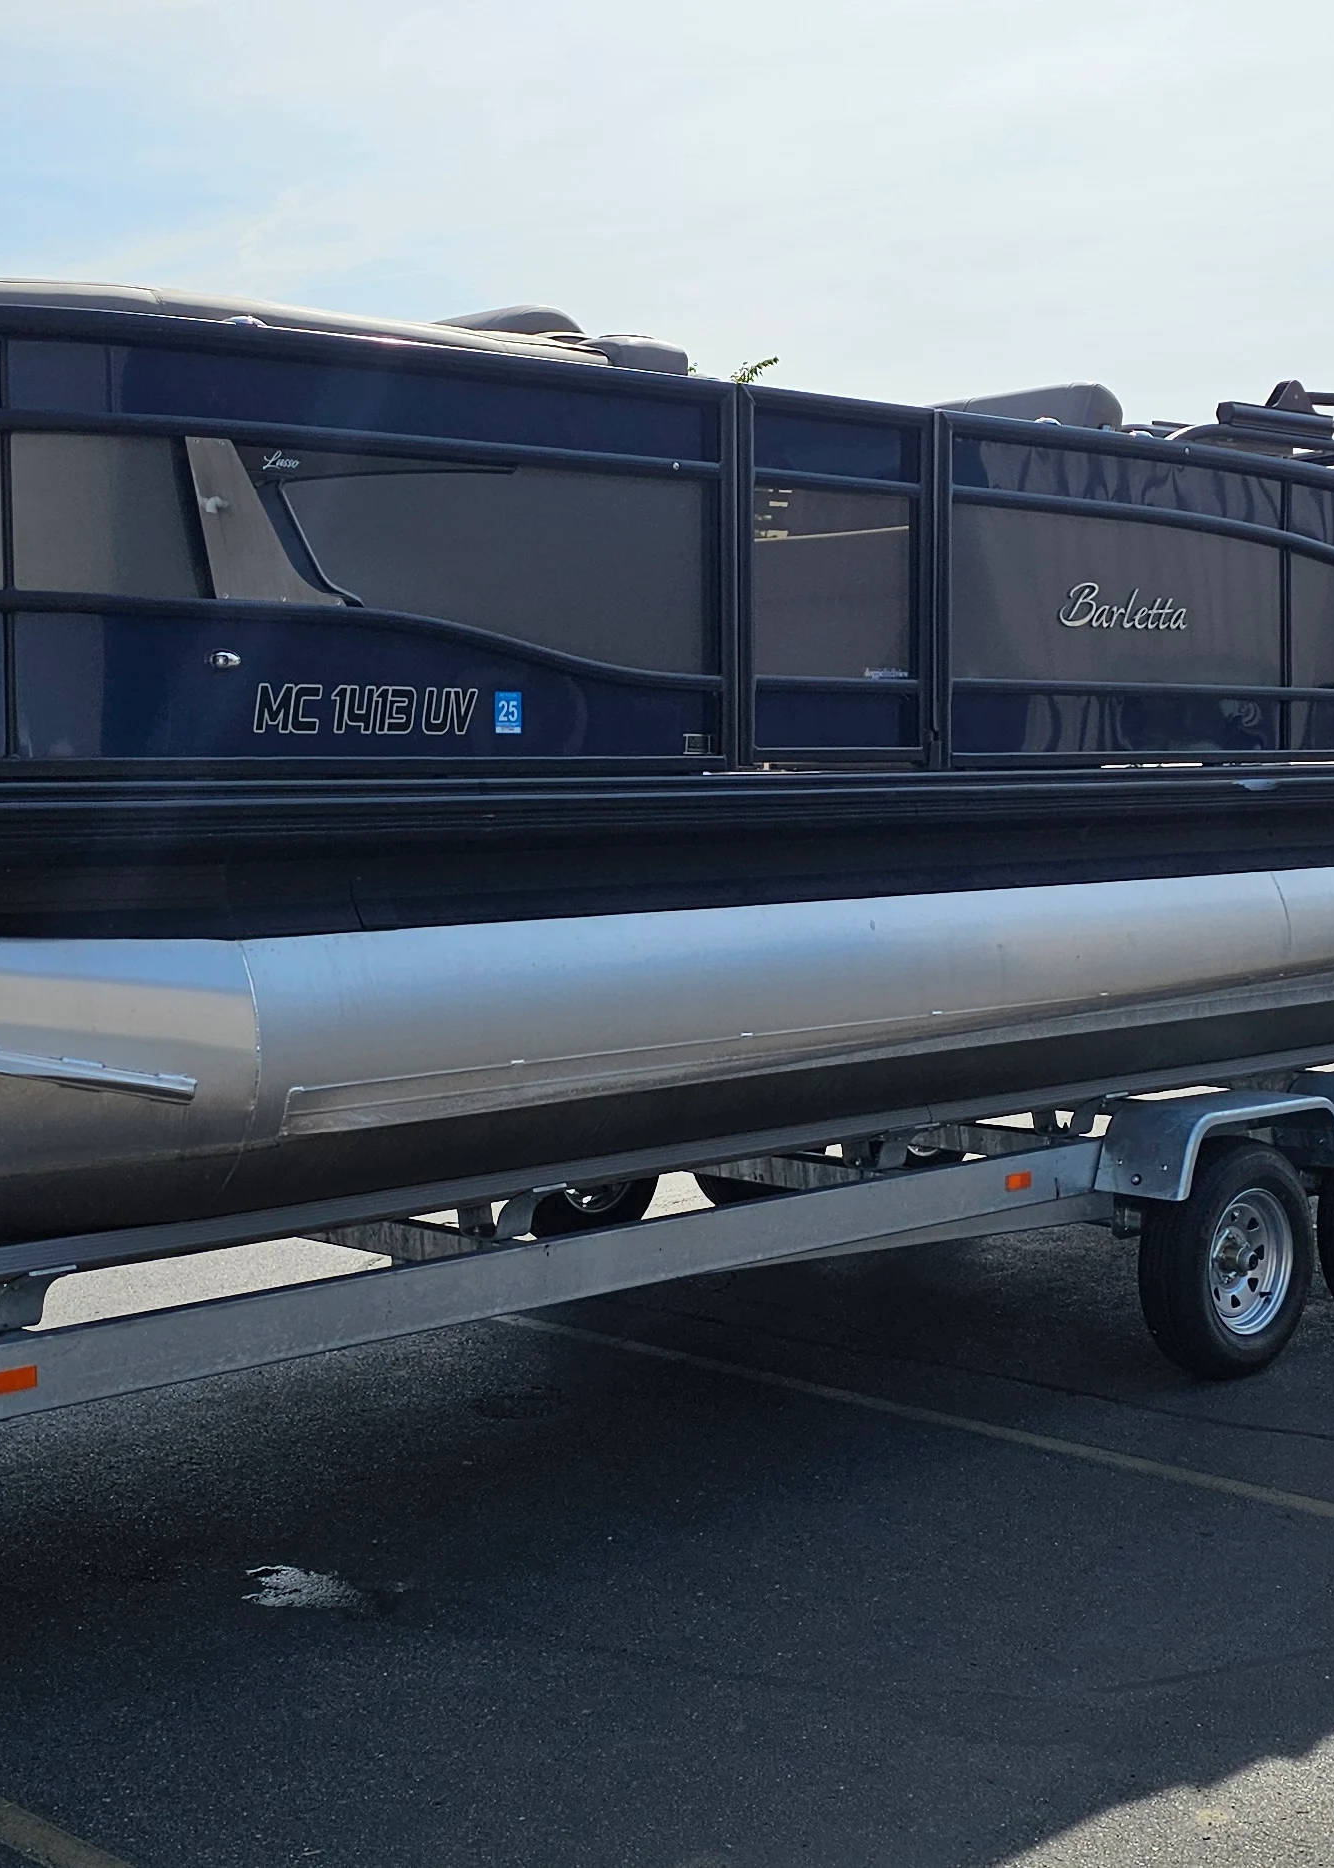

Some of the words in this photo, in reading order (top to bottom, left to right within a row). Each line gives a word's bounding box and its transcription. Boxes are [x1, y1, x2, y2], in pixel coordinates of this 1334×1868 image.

[262, 450, 300, 470] Lusso
[1059, 582, 1187, 630] Barletta
[253, 683, 323, 734] MC
[331, 684, 417, 735] 1413
[421, 687, 479, 735] UV
[498, 700, 518, 722] 25
